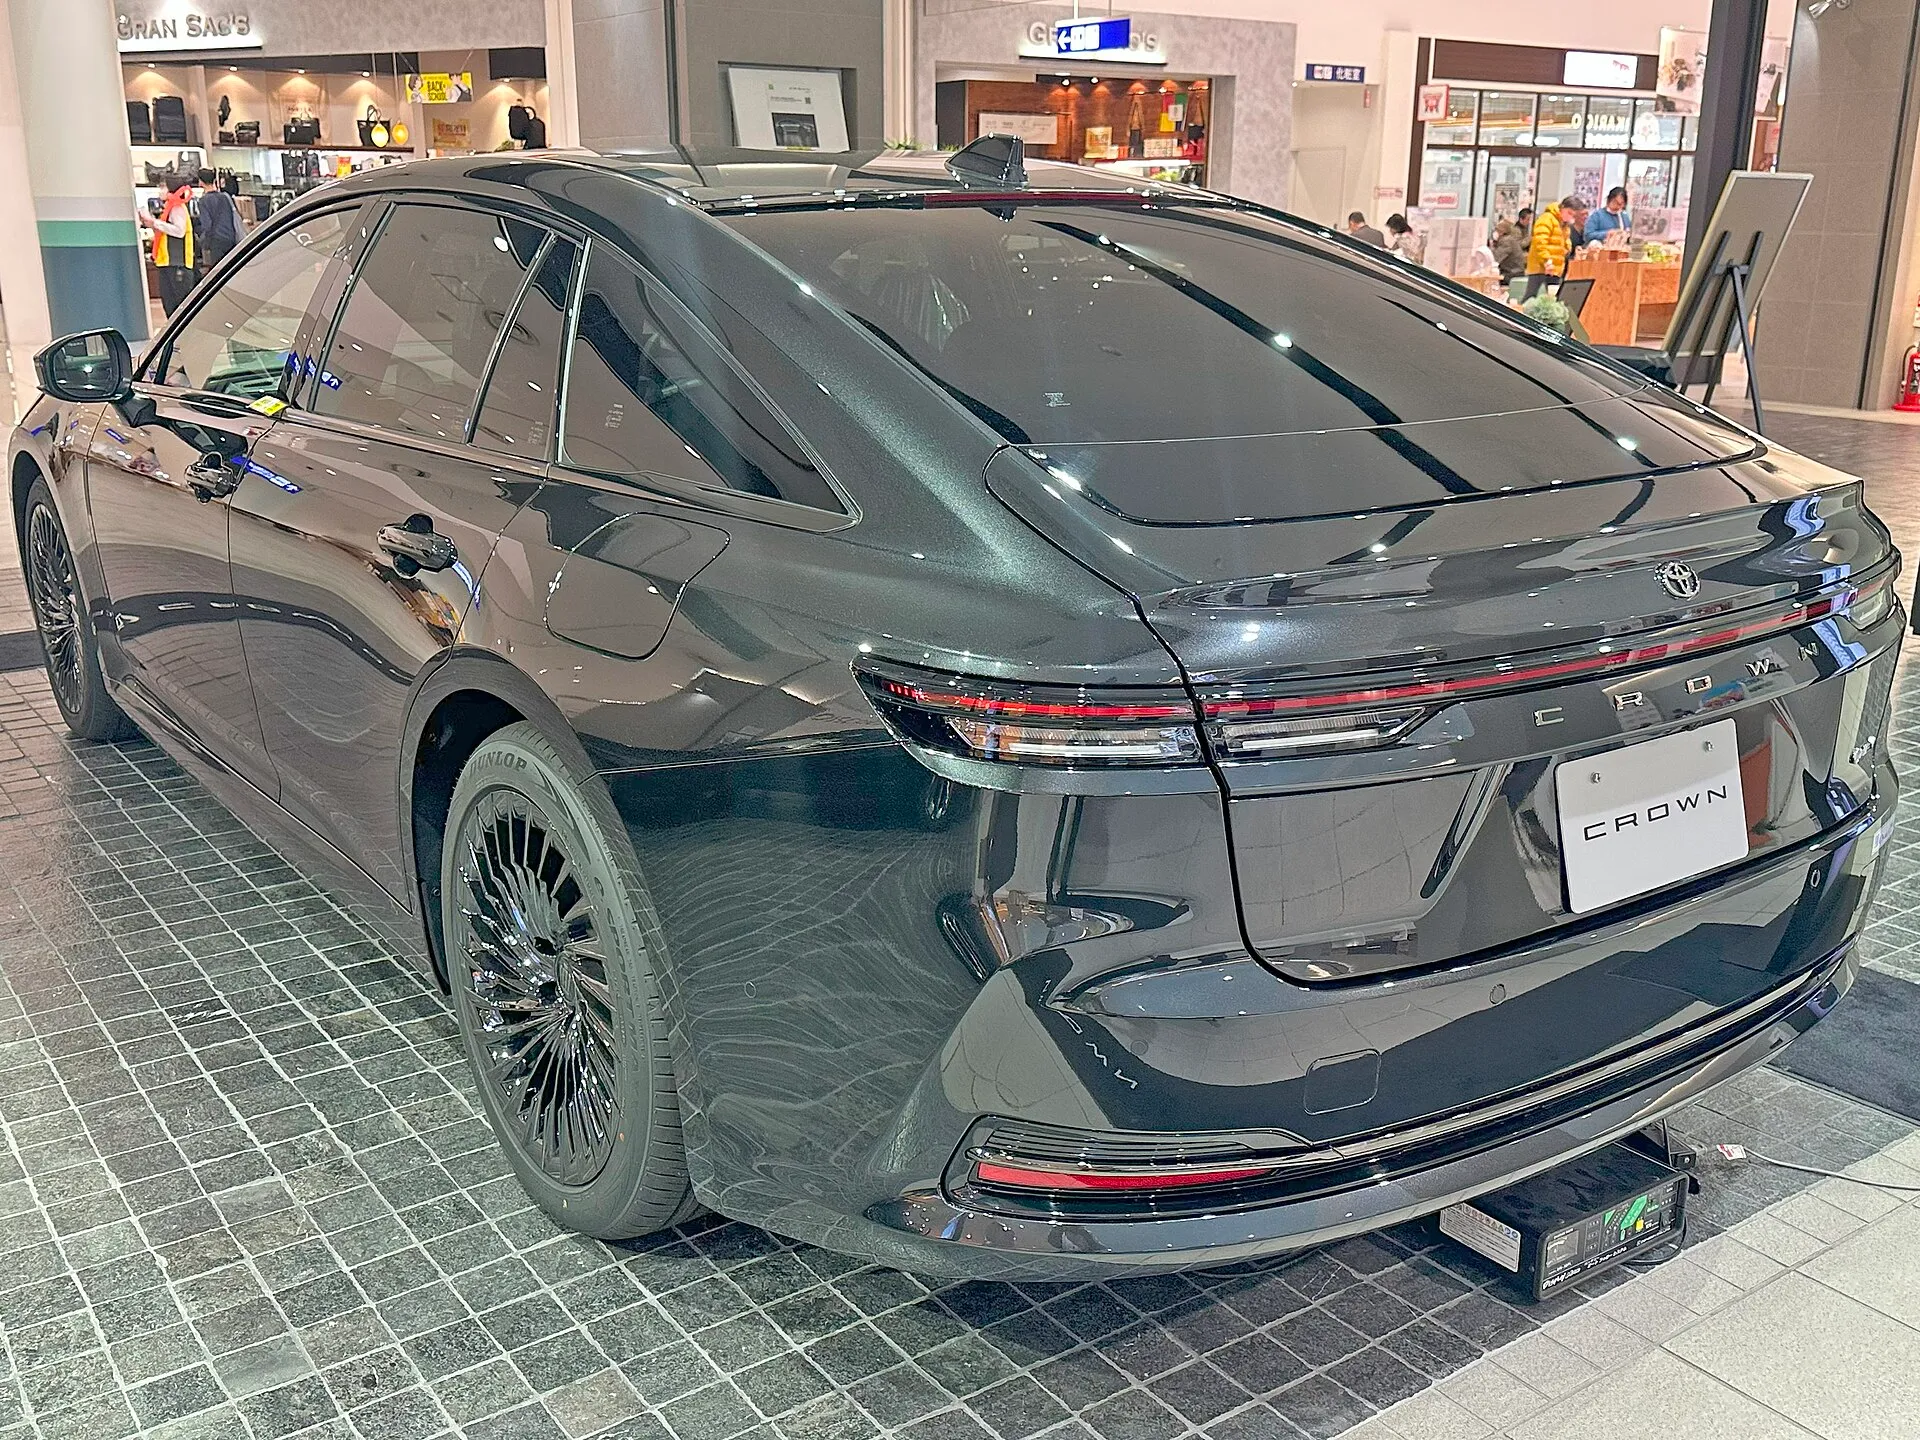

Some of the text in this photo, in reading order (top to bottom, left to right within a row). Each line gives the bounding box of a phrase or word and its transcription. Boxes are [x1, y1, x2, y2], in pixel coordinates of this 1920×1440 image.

[117, 14, 177, 40] GRAN
[1532, 640, 1820, 728] CROWN
[468, 751, 528, 776] DUNLOP
[1583, 785, 1728, 841] CROWN
